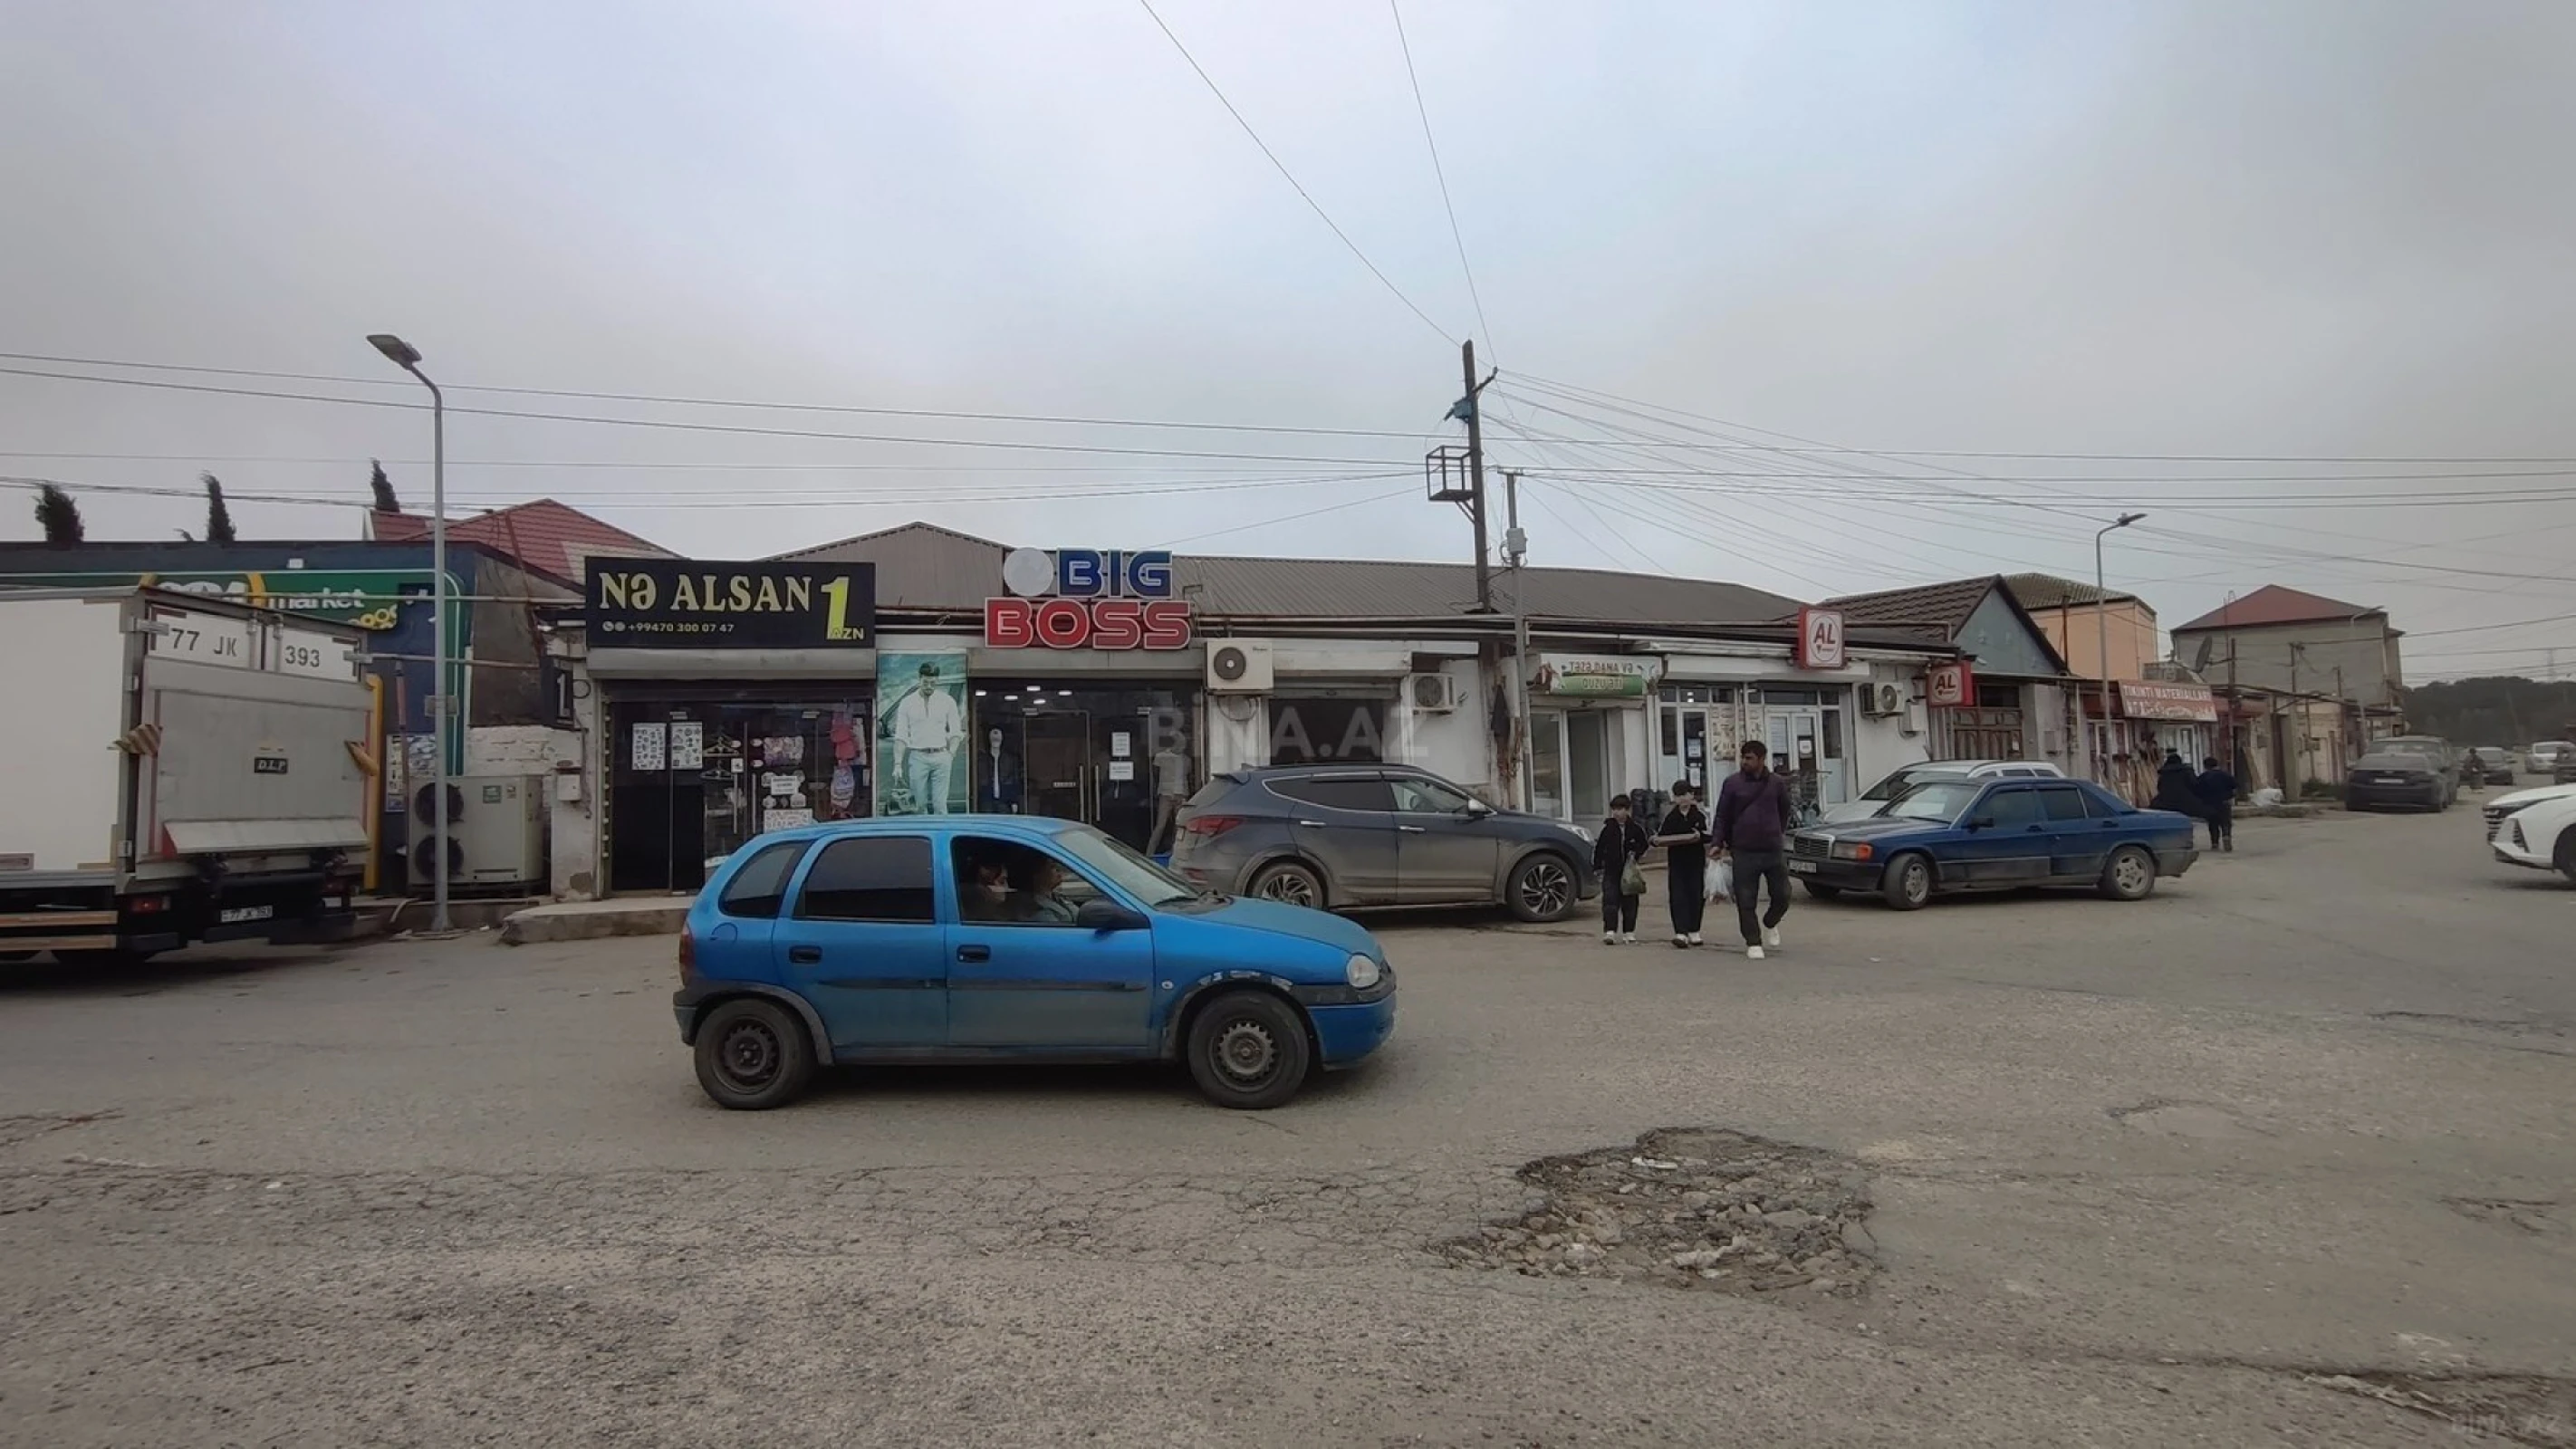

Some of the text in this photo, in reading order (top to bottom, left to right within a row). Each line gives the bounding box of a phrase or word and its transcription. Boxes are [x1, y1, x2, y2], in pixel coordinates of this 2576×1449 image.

[598, 572, 812, 612] NƏ ALSAN
[1057, 548, 1172, 599] BIG
[628, 622, 674, 632] +99470
[701, 622, 716, 632] 07
[985, 597, 1190, 649] BOSS
[1813, 623, 1836, 644] AL
[170, 628, 320, 667] 77 JK 393
[1935, 675, 1956, 689] AL
